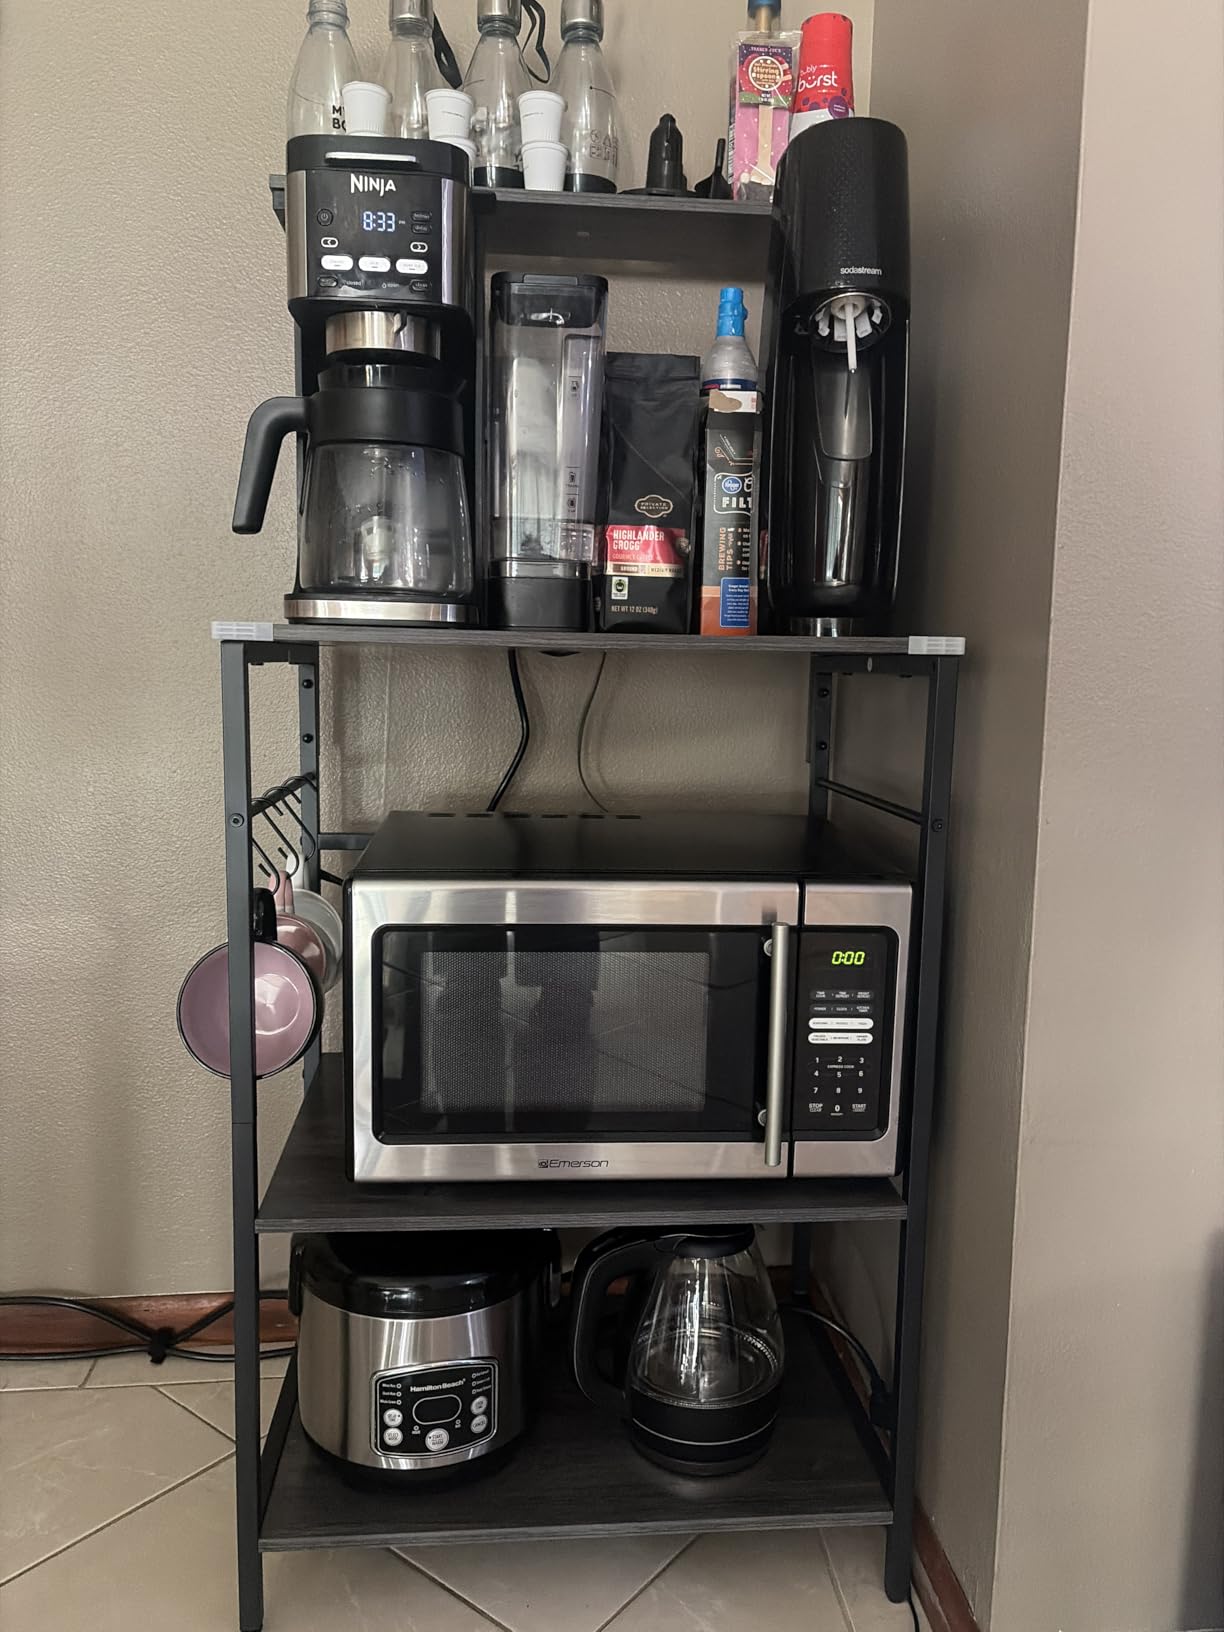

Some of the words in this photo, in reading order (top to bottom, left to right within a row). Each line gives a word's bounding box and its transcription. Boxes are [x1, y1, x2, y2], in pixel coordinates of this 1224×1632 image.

[332, 105, 345, 116] M
[350, 173, 396, 196] NINJA
[362, 211, 396, 232] 8:33
[840, 266, 882, 276] sodastream
[612, 529, 664, 542] HIGHLANDER
[612, 540, 640, 551] GROGG
[718, 528, 726, 570] BREWING
[726, 549, 734, 570] TIPS
[831, 951, 866, 965] 0:00
[549, 1159, 609, 1168] Emerson
[410, 1384, 442, 1392] Hamilton
[442, 1380, 464, 1389] Beach
